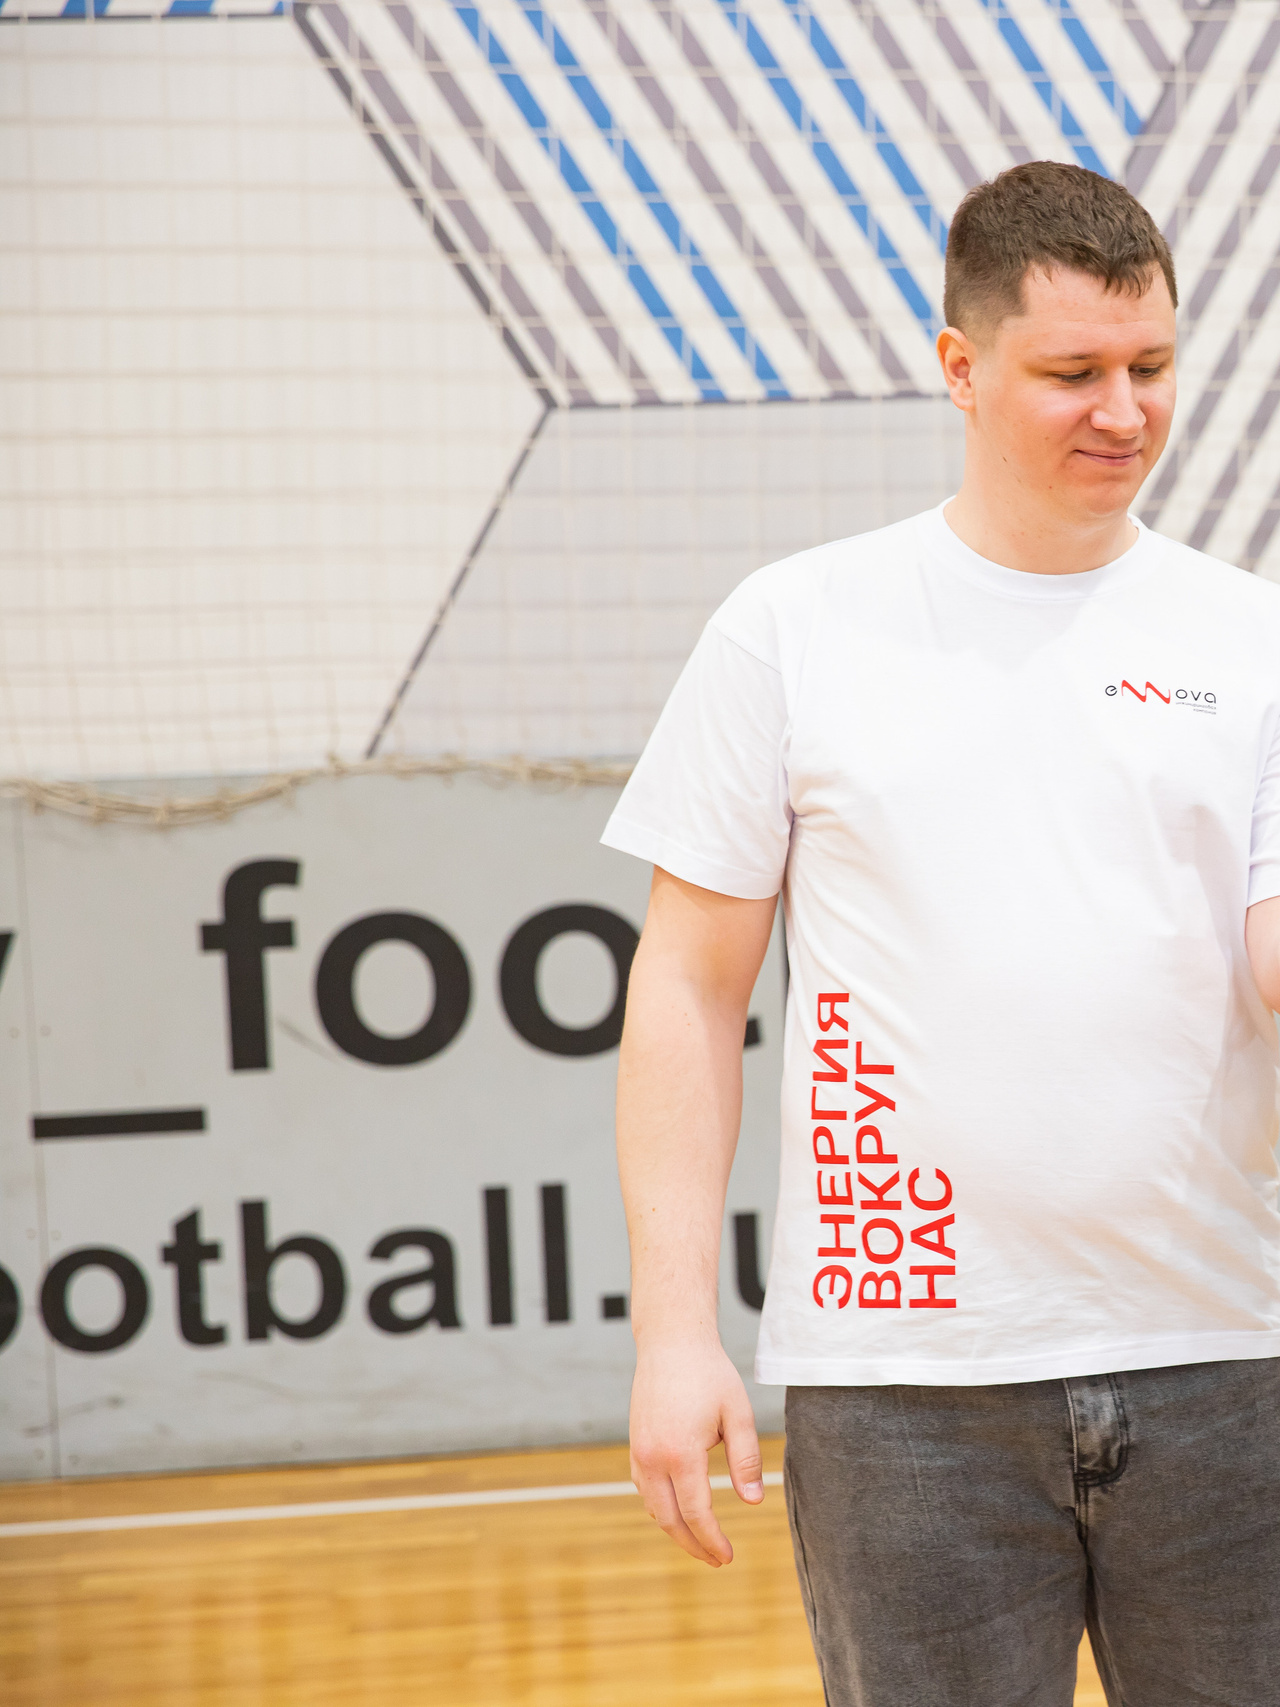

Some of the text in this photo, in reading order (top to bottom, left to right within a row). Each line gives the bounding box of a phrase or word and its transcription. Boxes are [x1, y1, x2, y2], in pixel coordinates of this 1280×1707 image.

[811, 992, 857, 1310] ЭНЕРГИЯ
[854, 1041, 904, 1309] ВОКРУГ
[907, 1167, 957, 1309] НАС
